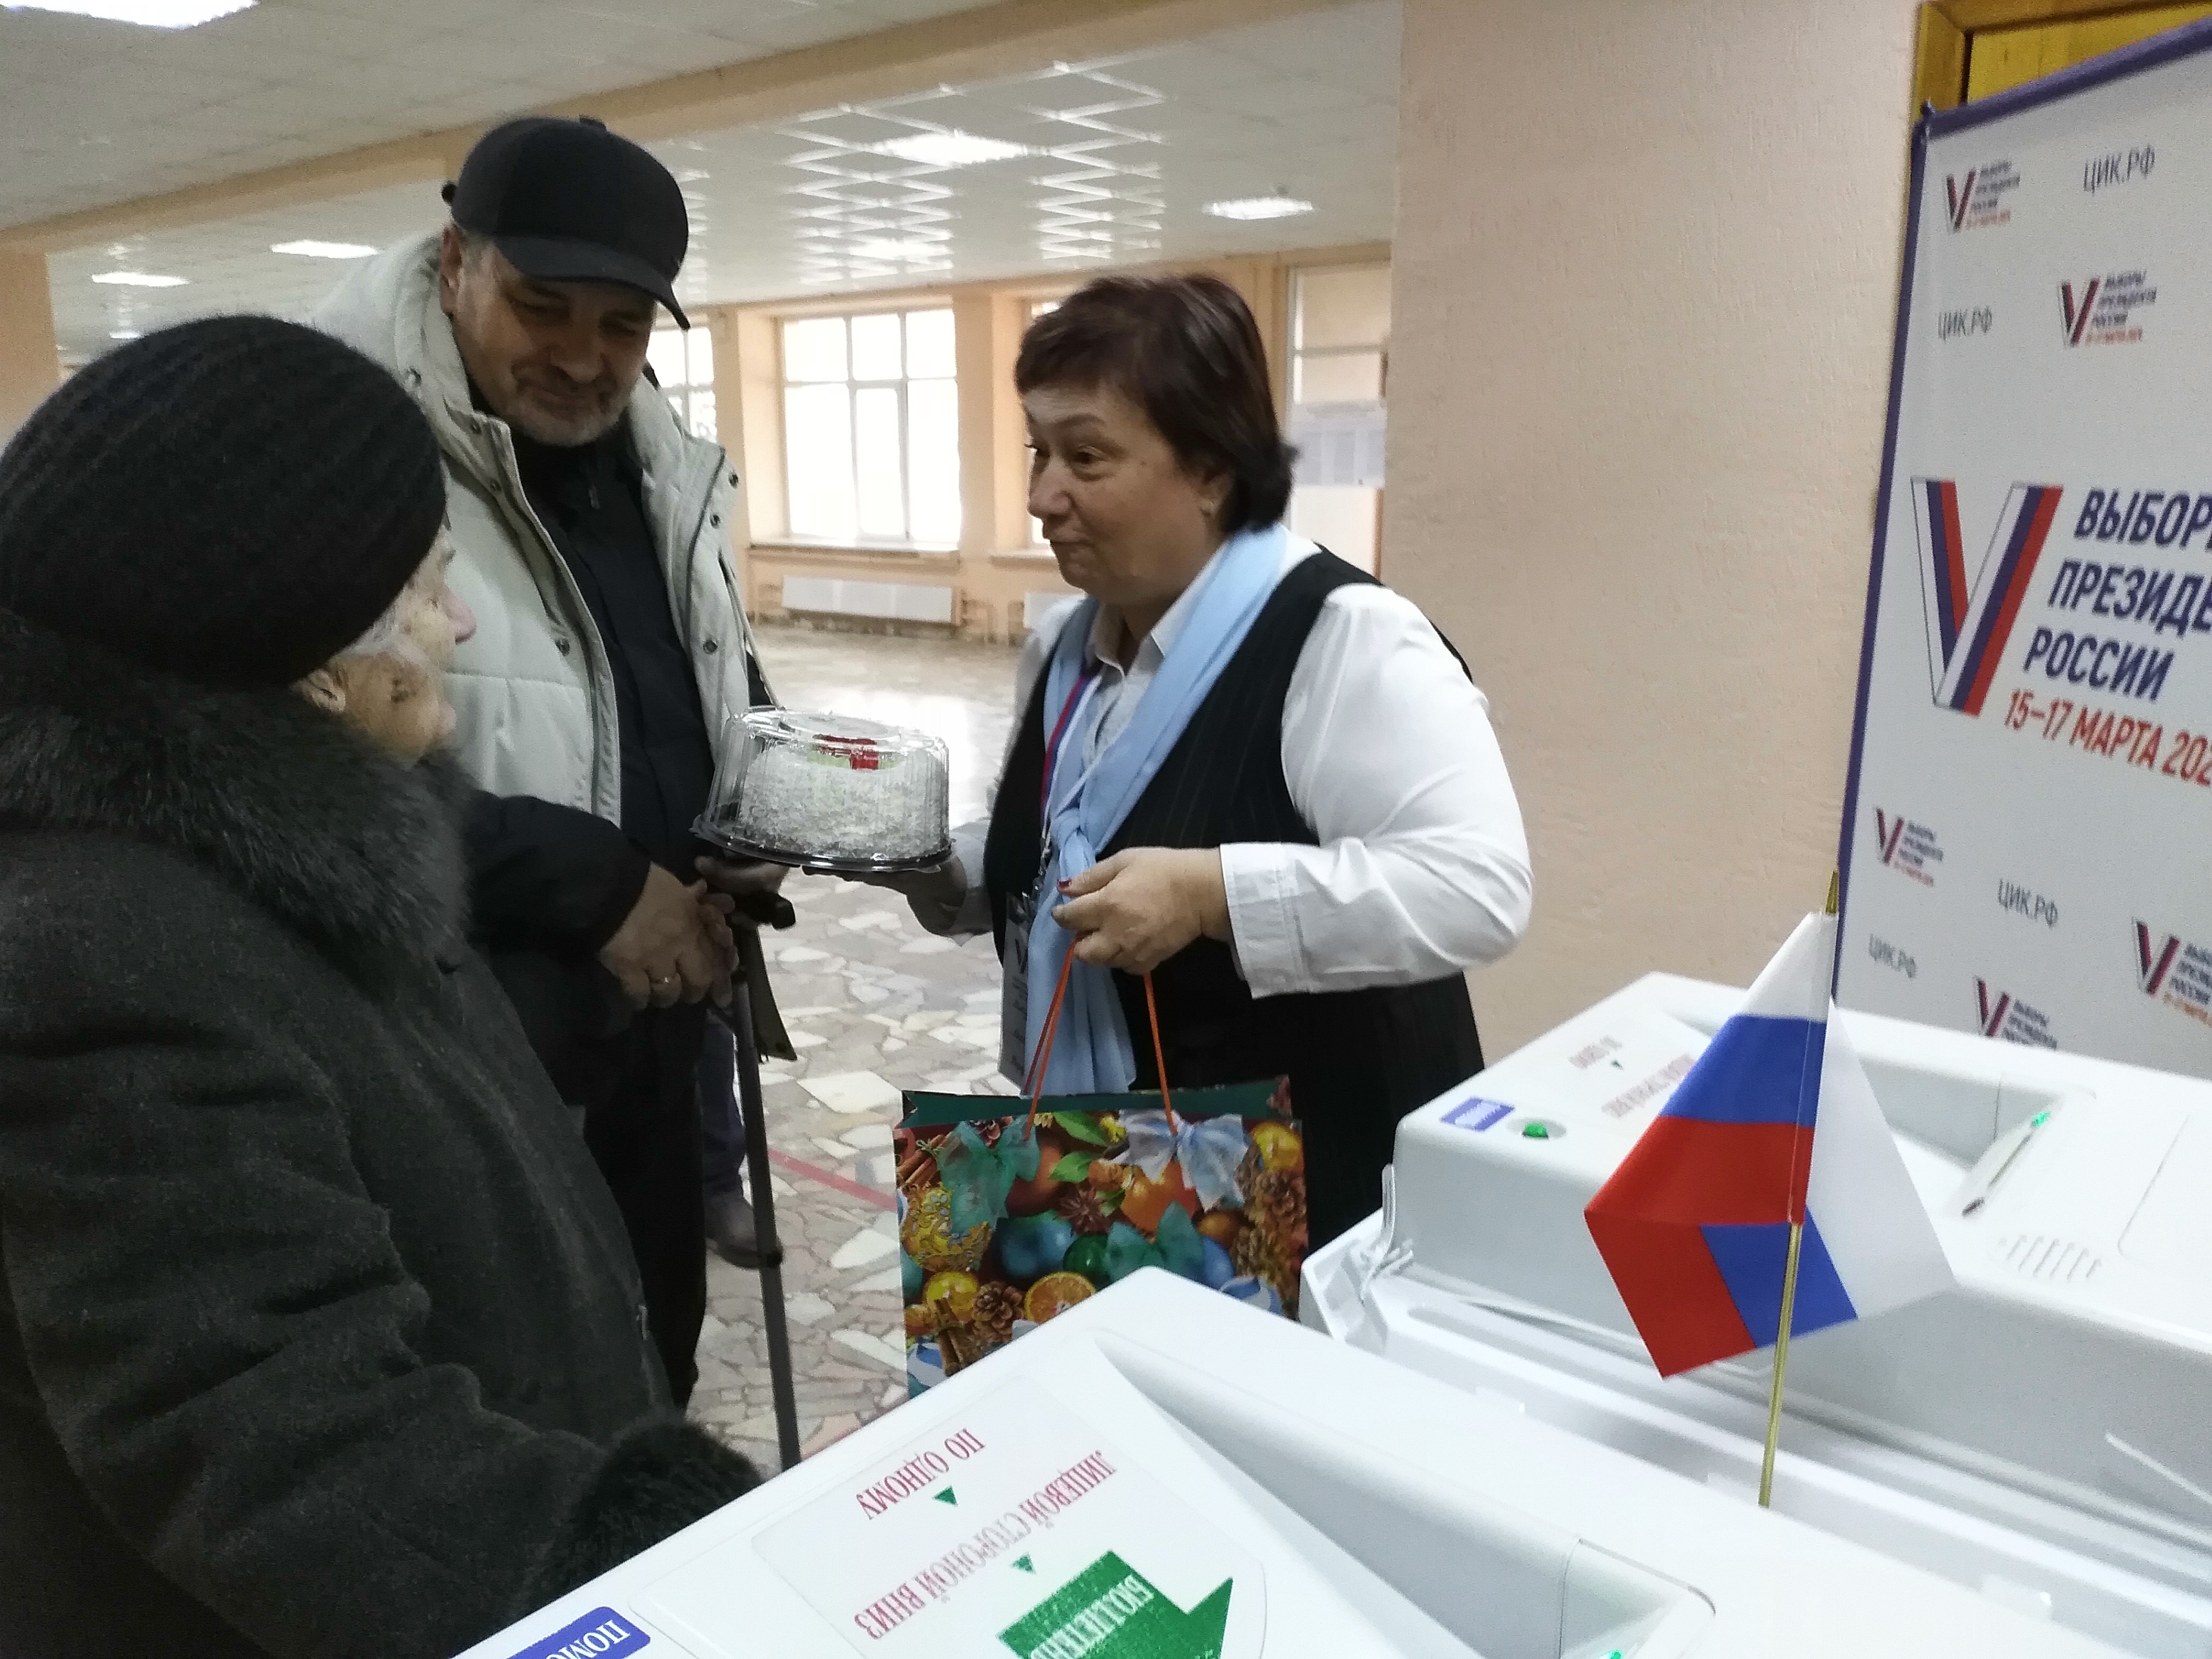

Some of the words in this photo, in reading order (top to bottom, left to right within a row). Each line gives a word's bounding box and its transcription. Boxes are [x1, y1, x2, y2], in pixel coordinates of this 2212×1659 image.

[2083, 143, 2155, 195] ЦИК.РФ
[1938, 306, 1992, 341] ЦИК.РФ
[2073, 487, 2212, 552] ВЫБОР
[2023, 626, 2174, 702] РОССИИ
[2069, 704, 2162, 769] МАРТА
[1997, 879, 2058, 929] ЦИК.РФ
[944, 1428, 986, 1460] ПО
[856, 1452, 949, 1520] ОДНОМУ
[1018, 1450, 1117, 1529] ЛИЦЕВОЙ
[913, 1512, 1031, 1603] СТОРОНОЙ
[546, 1619, 630, 1659] ПОМ
[854, 1583, 925, 1639] ВНИЗ
